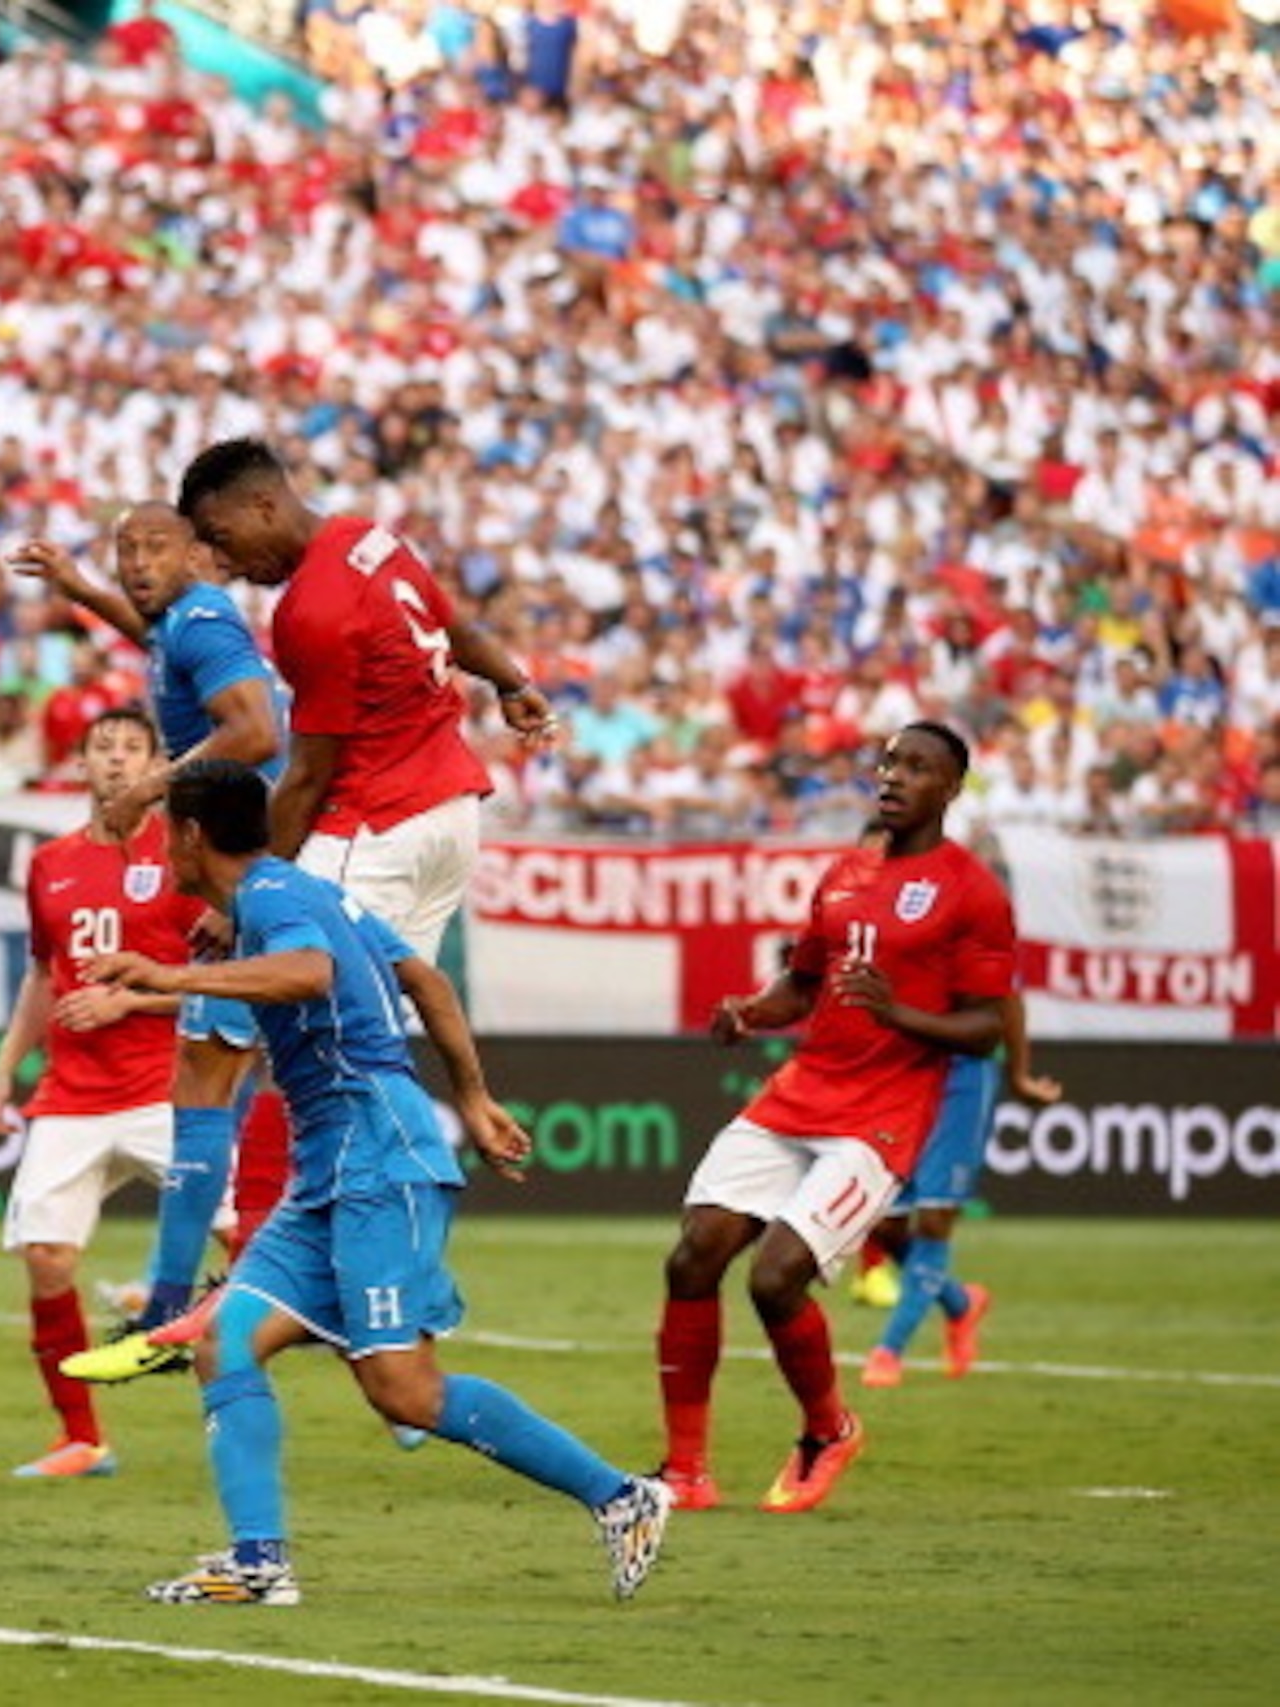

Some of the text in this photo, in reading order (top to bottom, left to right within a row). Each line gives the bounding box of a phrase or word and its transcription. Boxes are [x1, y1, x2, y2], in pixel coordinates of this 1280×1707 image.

[472, 851, 836, 926] SCUNTHO
[70, 907, 120, 959] 20
[1049, 951, 1253, 1004] LUTON
[826, 1176, 868, 1230] 11
[365, 1287, 402, 1330] H
